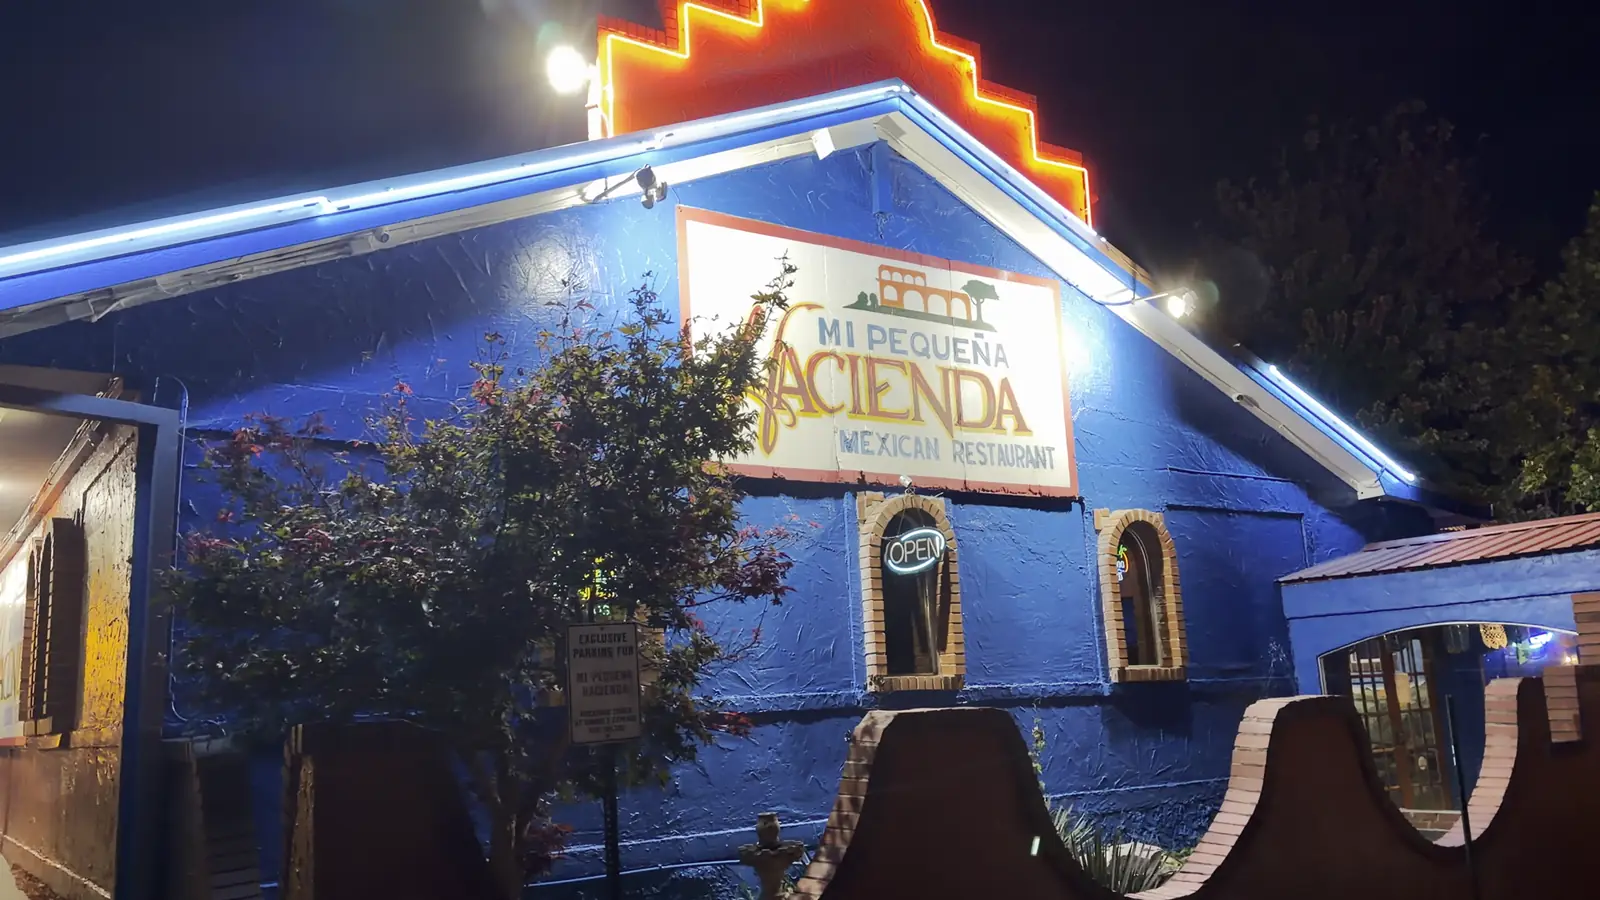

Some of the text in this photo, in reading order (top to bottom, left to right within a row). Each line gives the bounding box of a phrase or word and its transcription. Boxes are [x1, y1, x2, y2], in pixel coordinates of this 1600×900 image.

[818, 317, 1010, 369] MI PEQUEÑA
[839, 429, 1056, 469] MEXICAN RESTAURANT
[889, 536, 941, 565] OPEN
[573, 647, 613, 659] PARKING
[579, 632, 628, 645] EXCLUSIVE
